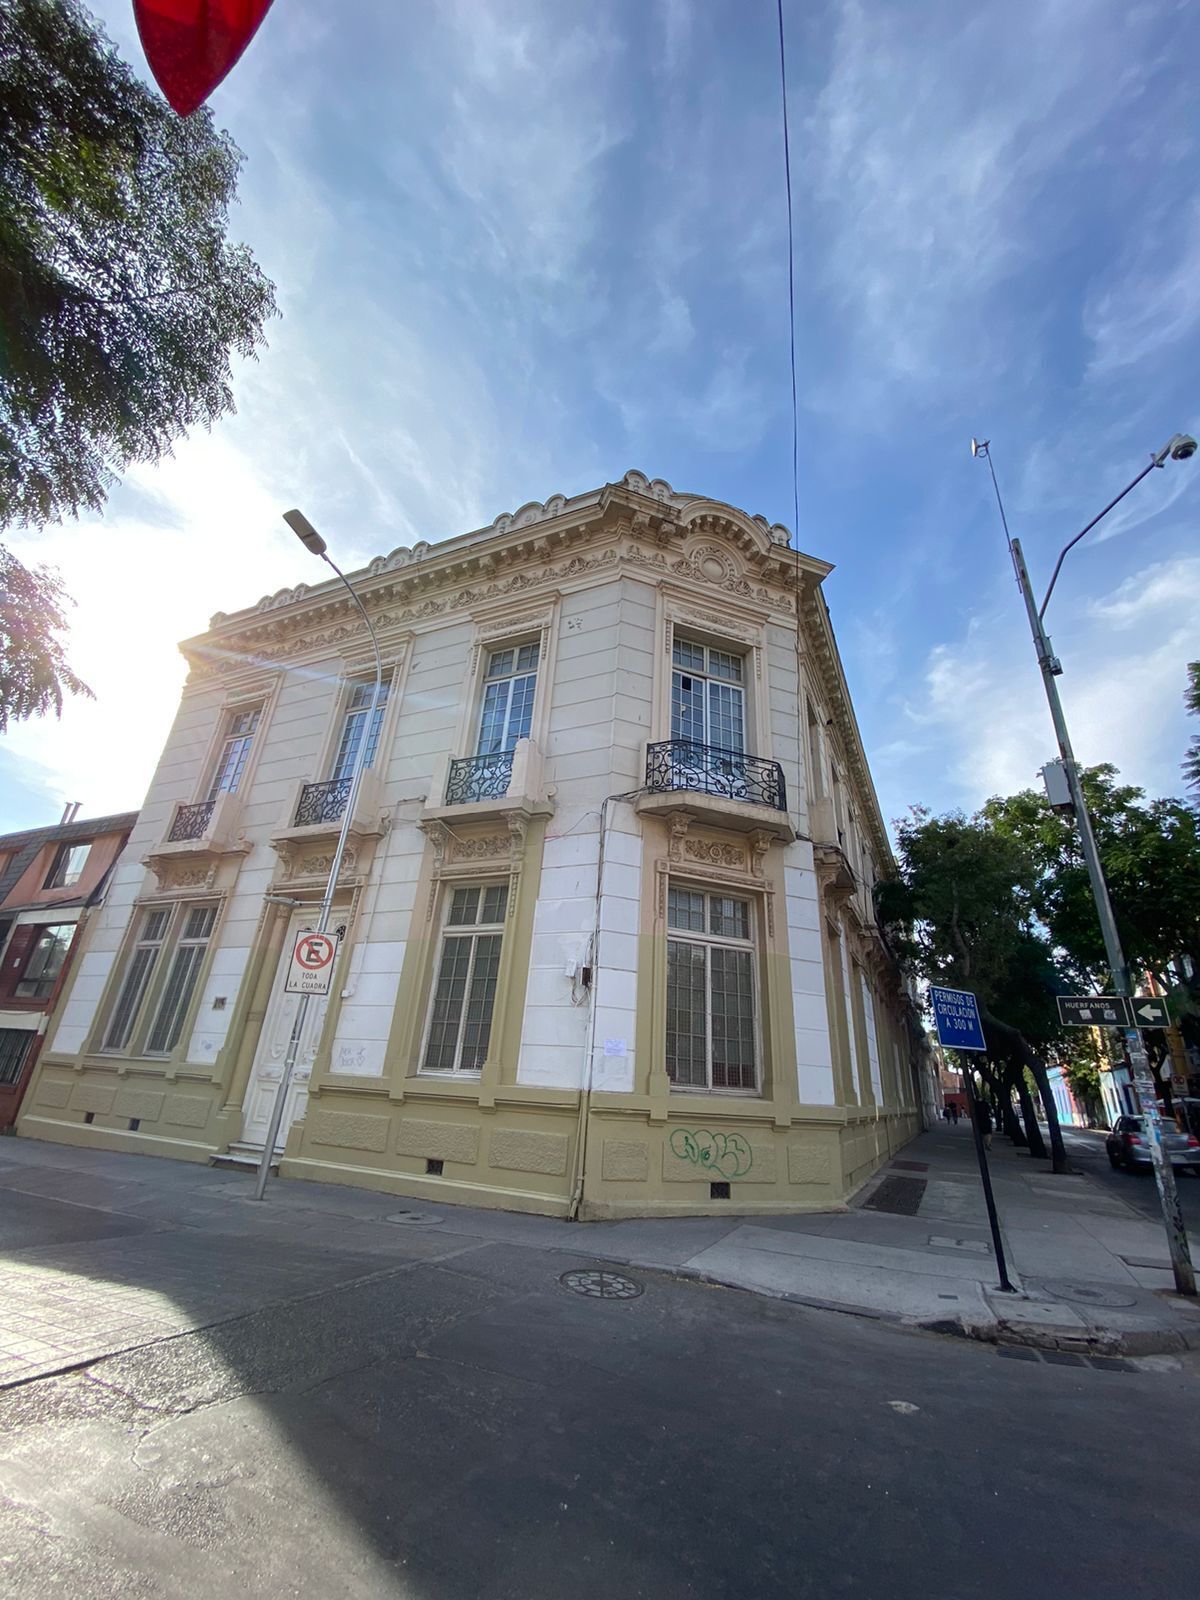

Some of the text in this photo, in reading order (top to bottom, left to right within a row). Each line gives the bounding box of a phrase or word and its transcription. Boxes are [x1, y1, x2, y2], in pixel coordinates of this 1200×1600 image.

[302, 972, 317, 980] TODA
[302, 981, 326, 989] CUADRA
[934, 990, 974, 1007] PERMISOS DE
[946, 1017, 952, 1029] A
[953, 1018, 967, 1031] 300
